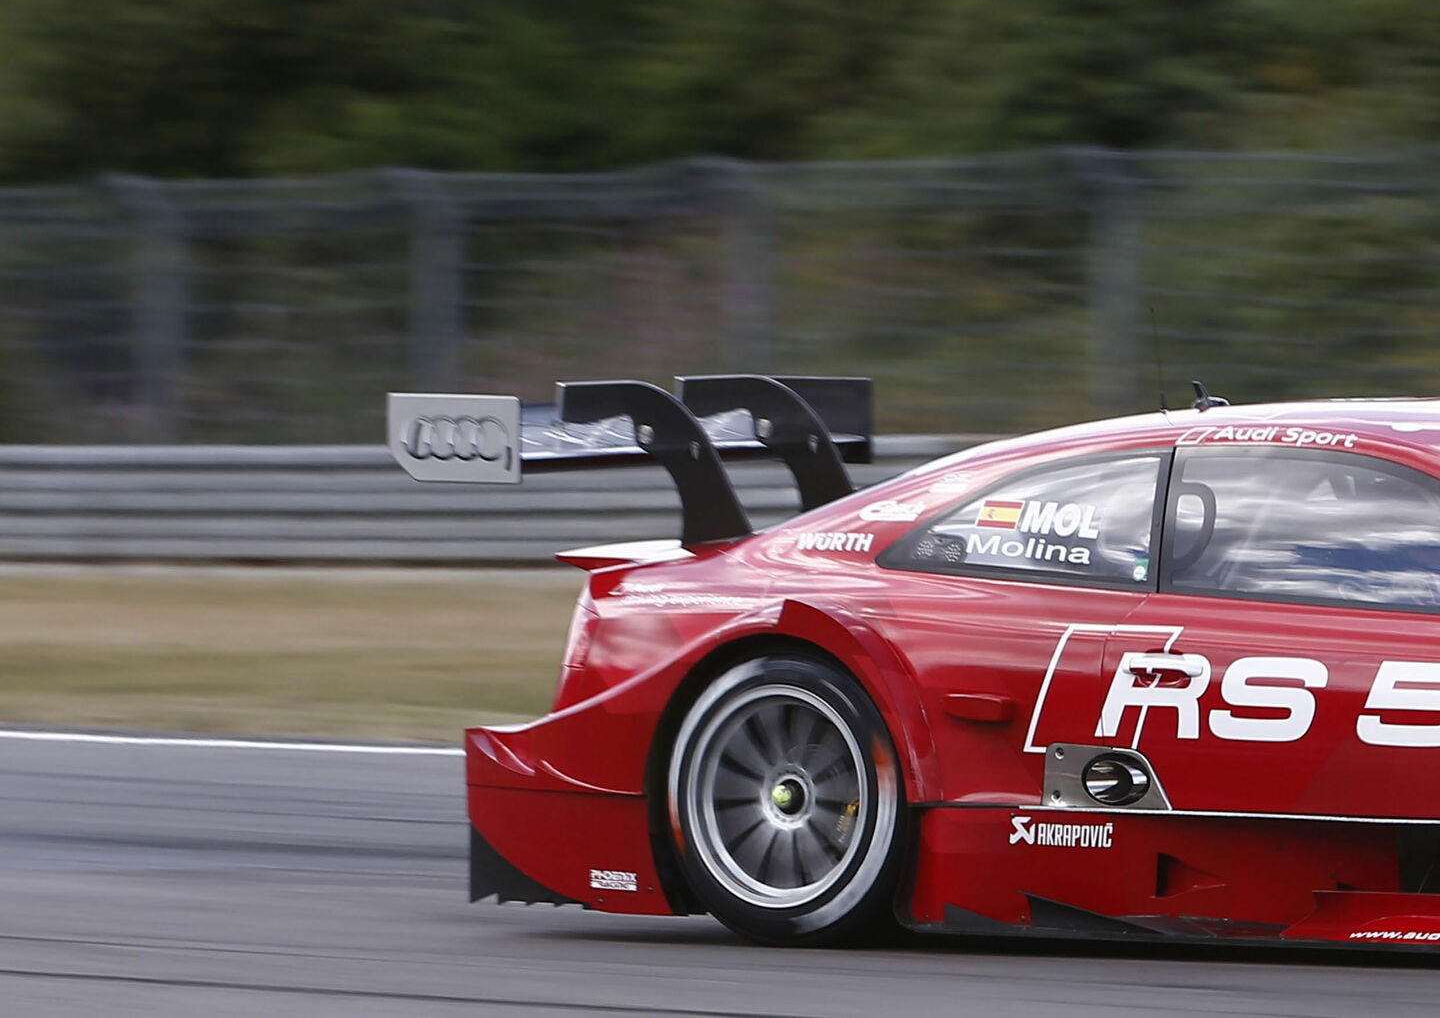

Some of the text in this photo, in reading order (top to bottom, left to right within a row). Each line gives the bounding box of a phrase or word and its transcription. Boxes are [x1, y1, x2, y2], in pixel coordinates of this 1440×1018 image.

[1213, 426, 1358, 447] Audi Sport
[1020, 500, 1100, 540] MOL
[966, 533, 1091, 565] Molina
[1094, 652, 1329, 742] RS
